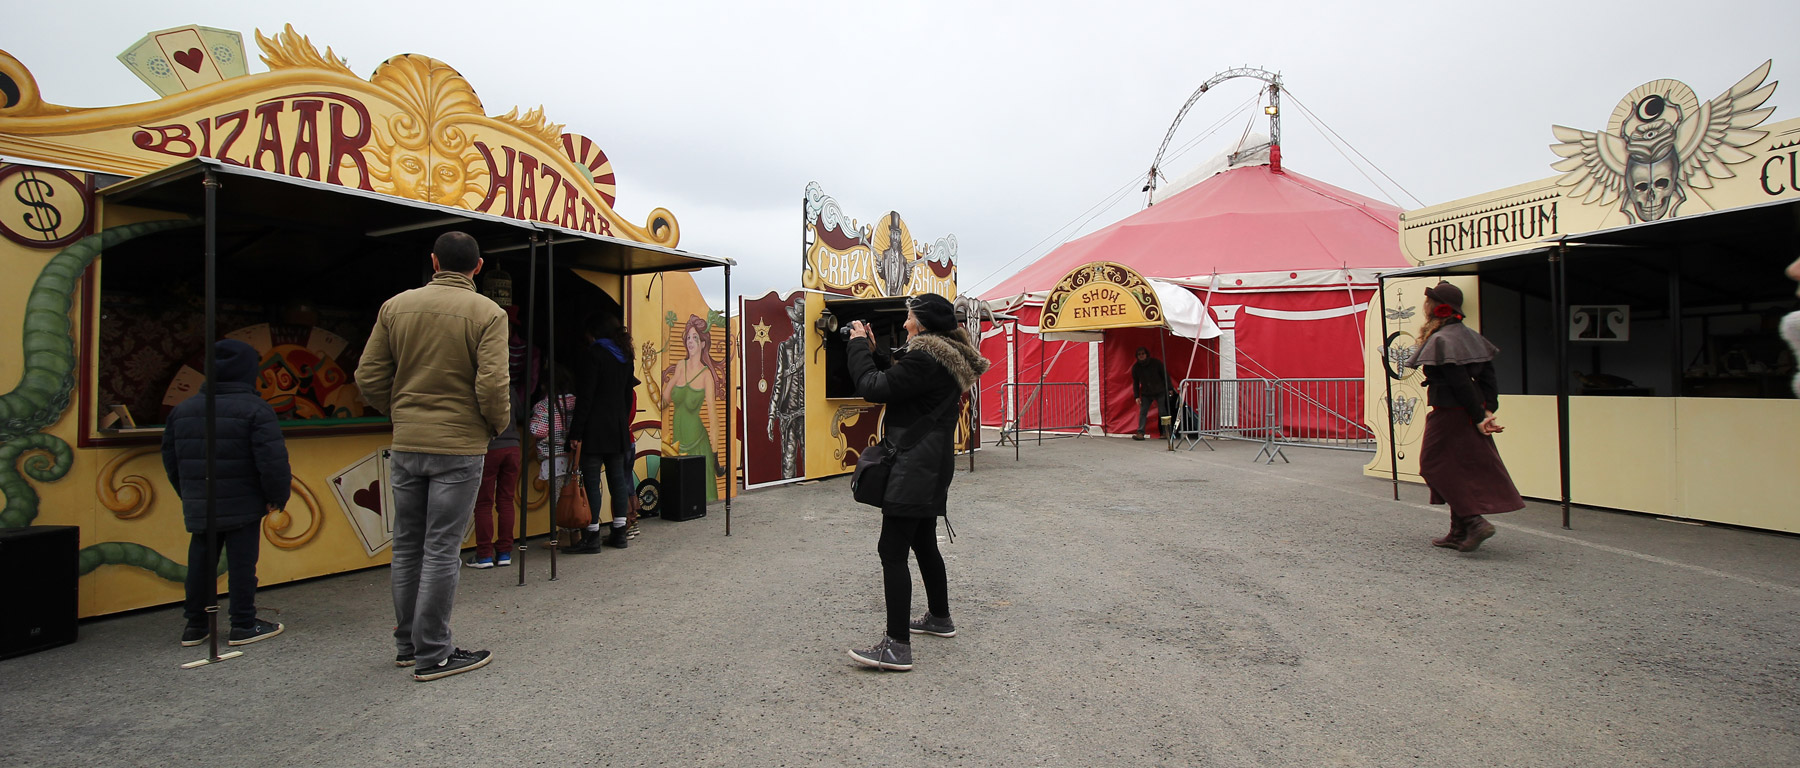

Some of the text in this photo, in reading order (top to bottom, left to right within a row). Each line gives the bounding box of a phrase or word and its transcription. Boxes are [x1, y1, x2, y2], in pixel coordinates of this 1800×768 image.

[132, 91, 377, 193] BIZAAR
[473, 141, 616, 238] HAZAAR
[1427, 201, 1559, 257] ARMARIUM
[817, 246, 951, 301] CRAZY SHOOT
[1081, 288, 1121, 304] SHOW
[1074, 303, 1127, 319] ENTREE
